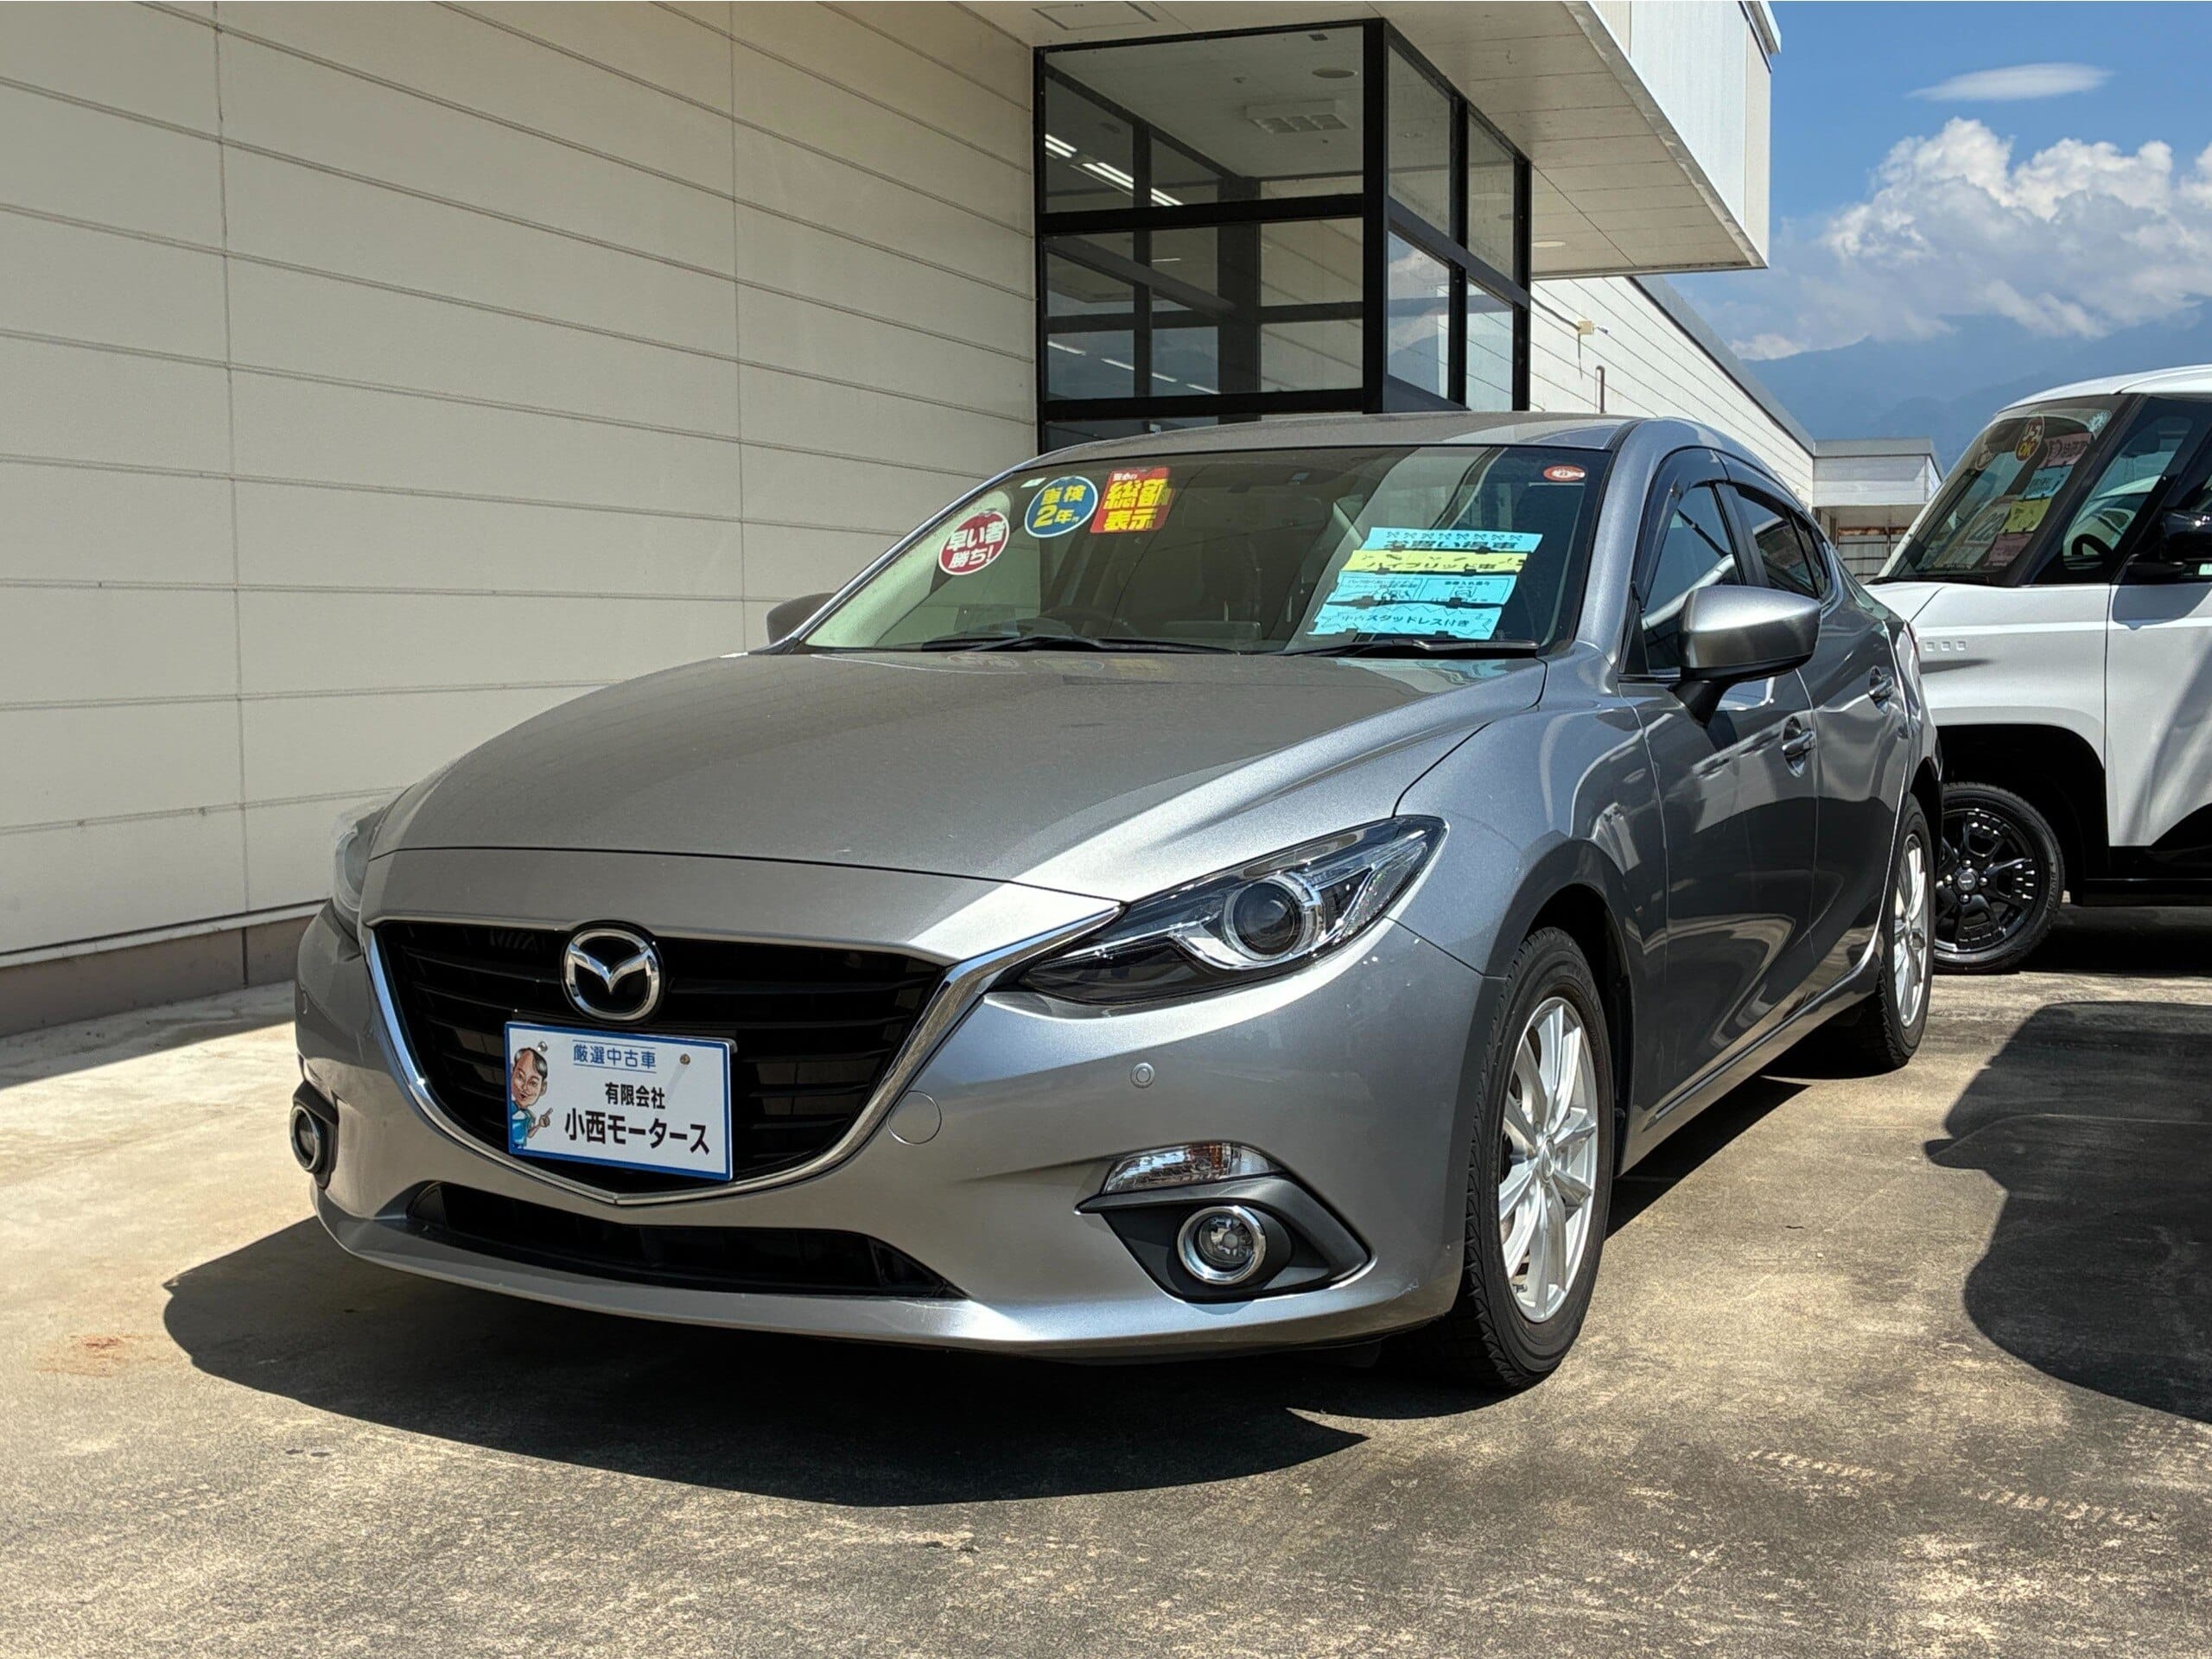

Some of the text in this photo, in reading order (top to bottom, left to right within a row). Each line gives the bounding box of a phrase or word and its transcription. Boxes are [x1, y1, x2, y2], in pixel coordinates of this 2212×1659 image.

[1040, 485, 1087, 505] 車検
[1103, 479, 1173, 509] 総額
[1104, 508, 1156, 531] 表示
[947, 520, 1005, 550] 早い者
[573, 1044, 657, 1070] 厳選中古車
[605, 1082, 666, 1109] 有限会社
[564, 1107, 710, 1155] 小西モータース
